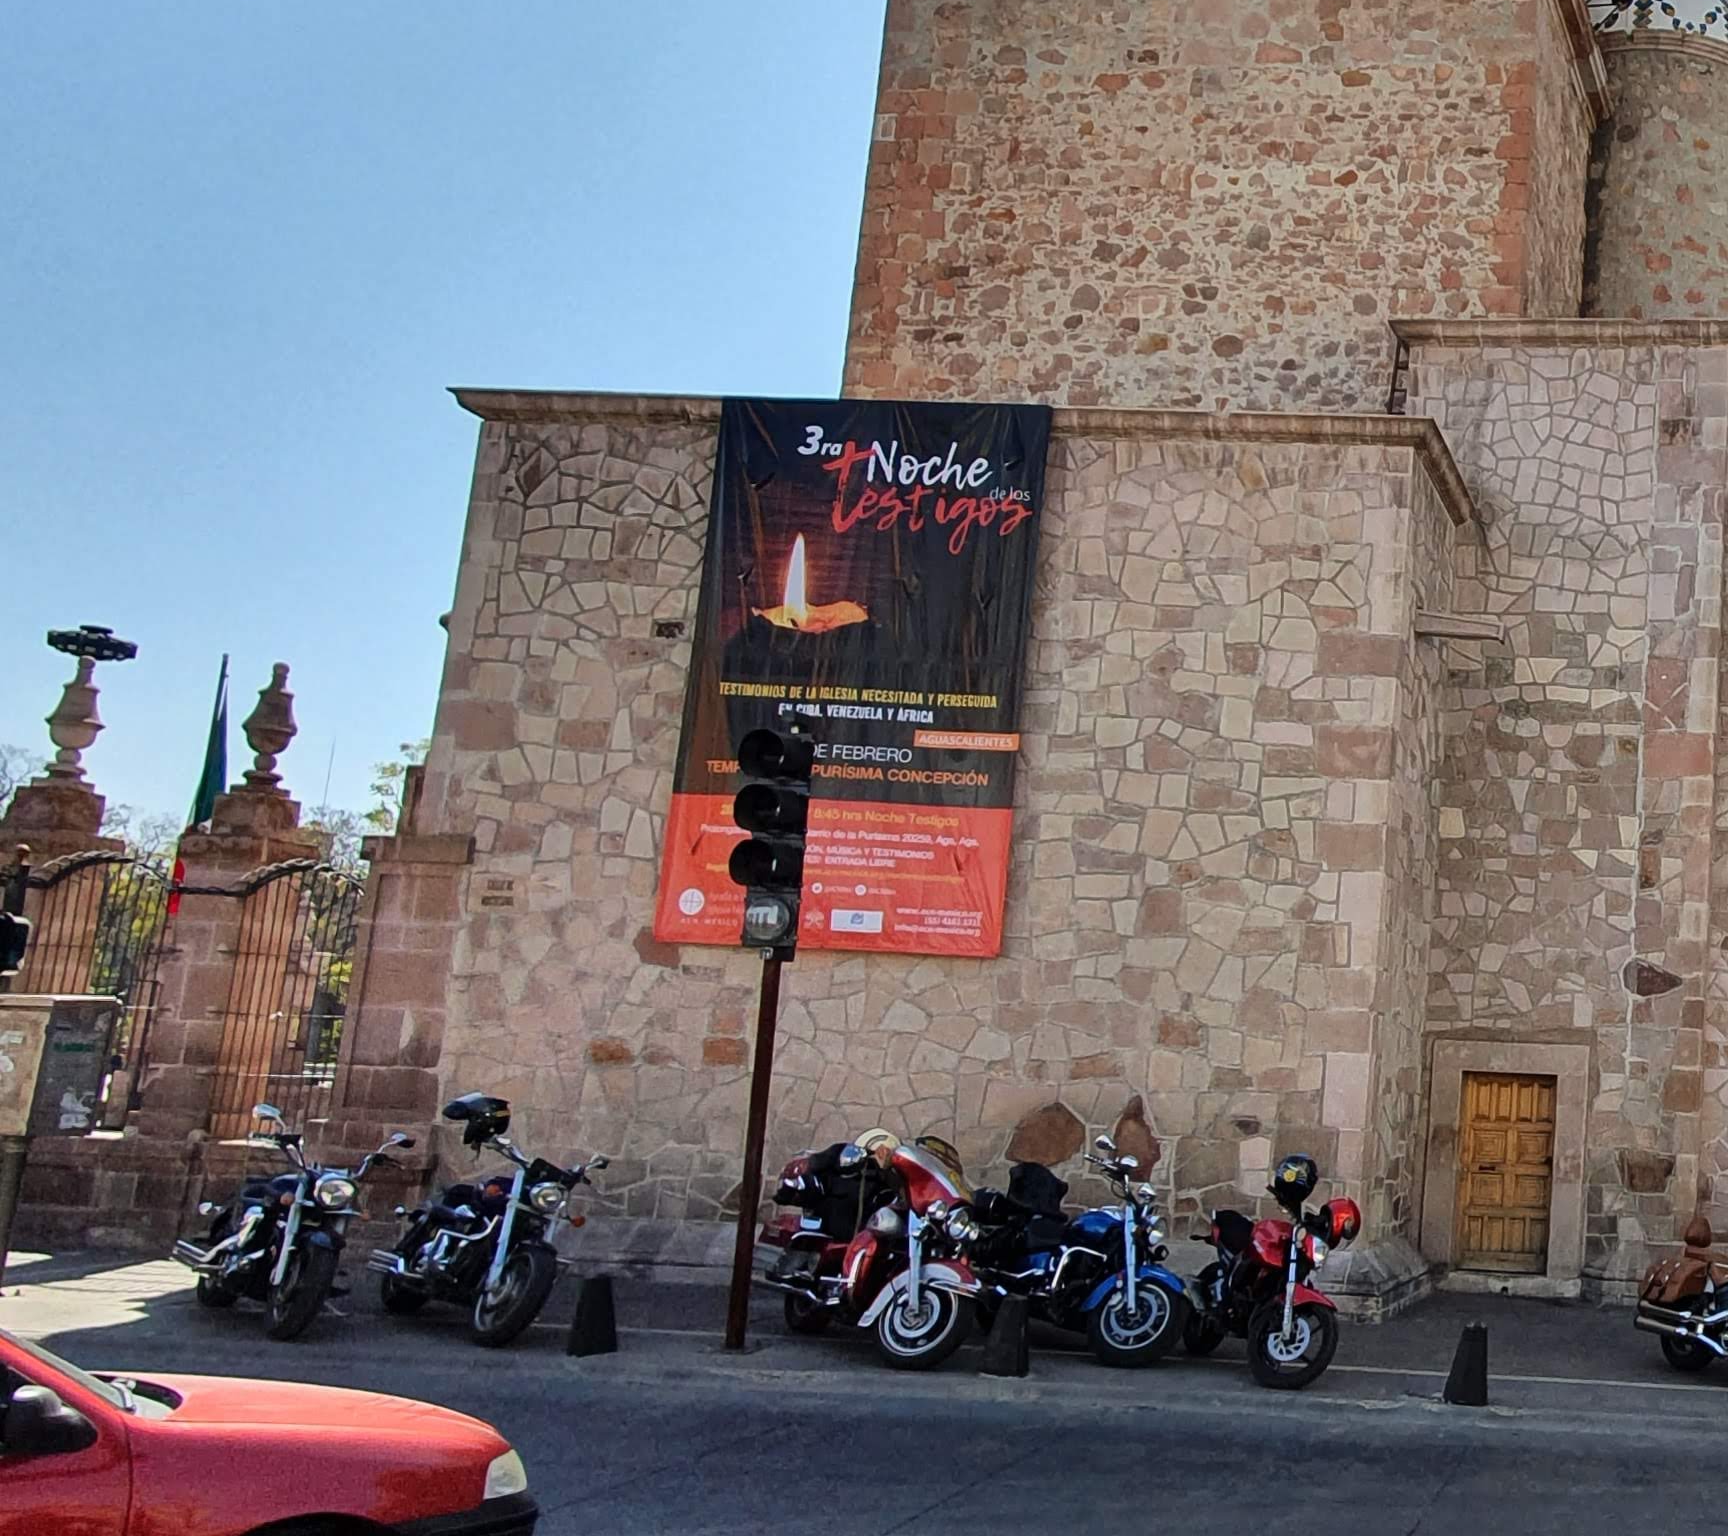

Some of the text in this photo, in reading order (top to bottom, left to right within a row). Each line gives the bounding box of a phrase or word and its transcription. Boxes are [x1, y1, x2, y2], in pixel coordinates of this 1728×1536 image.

[797, 425, 843, 456] 3ra
[866, 440, 993, 490] Noche
[822, 439, 1033, 555] Testigos
[989, 486, 1031, 501] de los
[719, 681, 998, 708] TESTIMONIOS DE LA IGLESIA NECESITADA Y PERSEGUIDA
[826, 704, 883, 721] VENEZUELA
[887, 708, 895, 721] Y
[919, 733, 1013, 748] AGUASCALIENTES
[831, 744, 913, 763] FEBRERO
[811, 763, 883, 781] PURÍSIMA
[887, 768, 989, 786] CONCEPCIÓN
